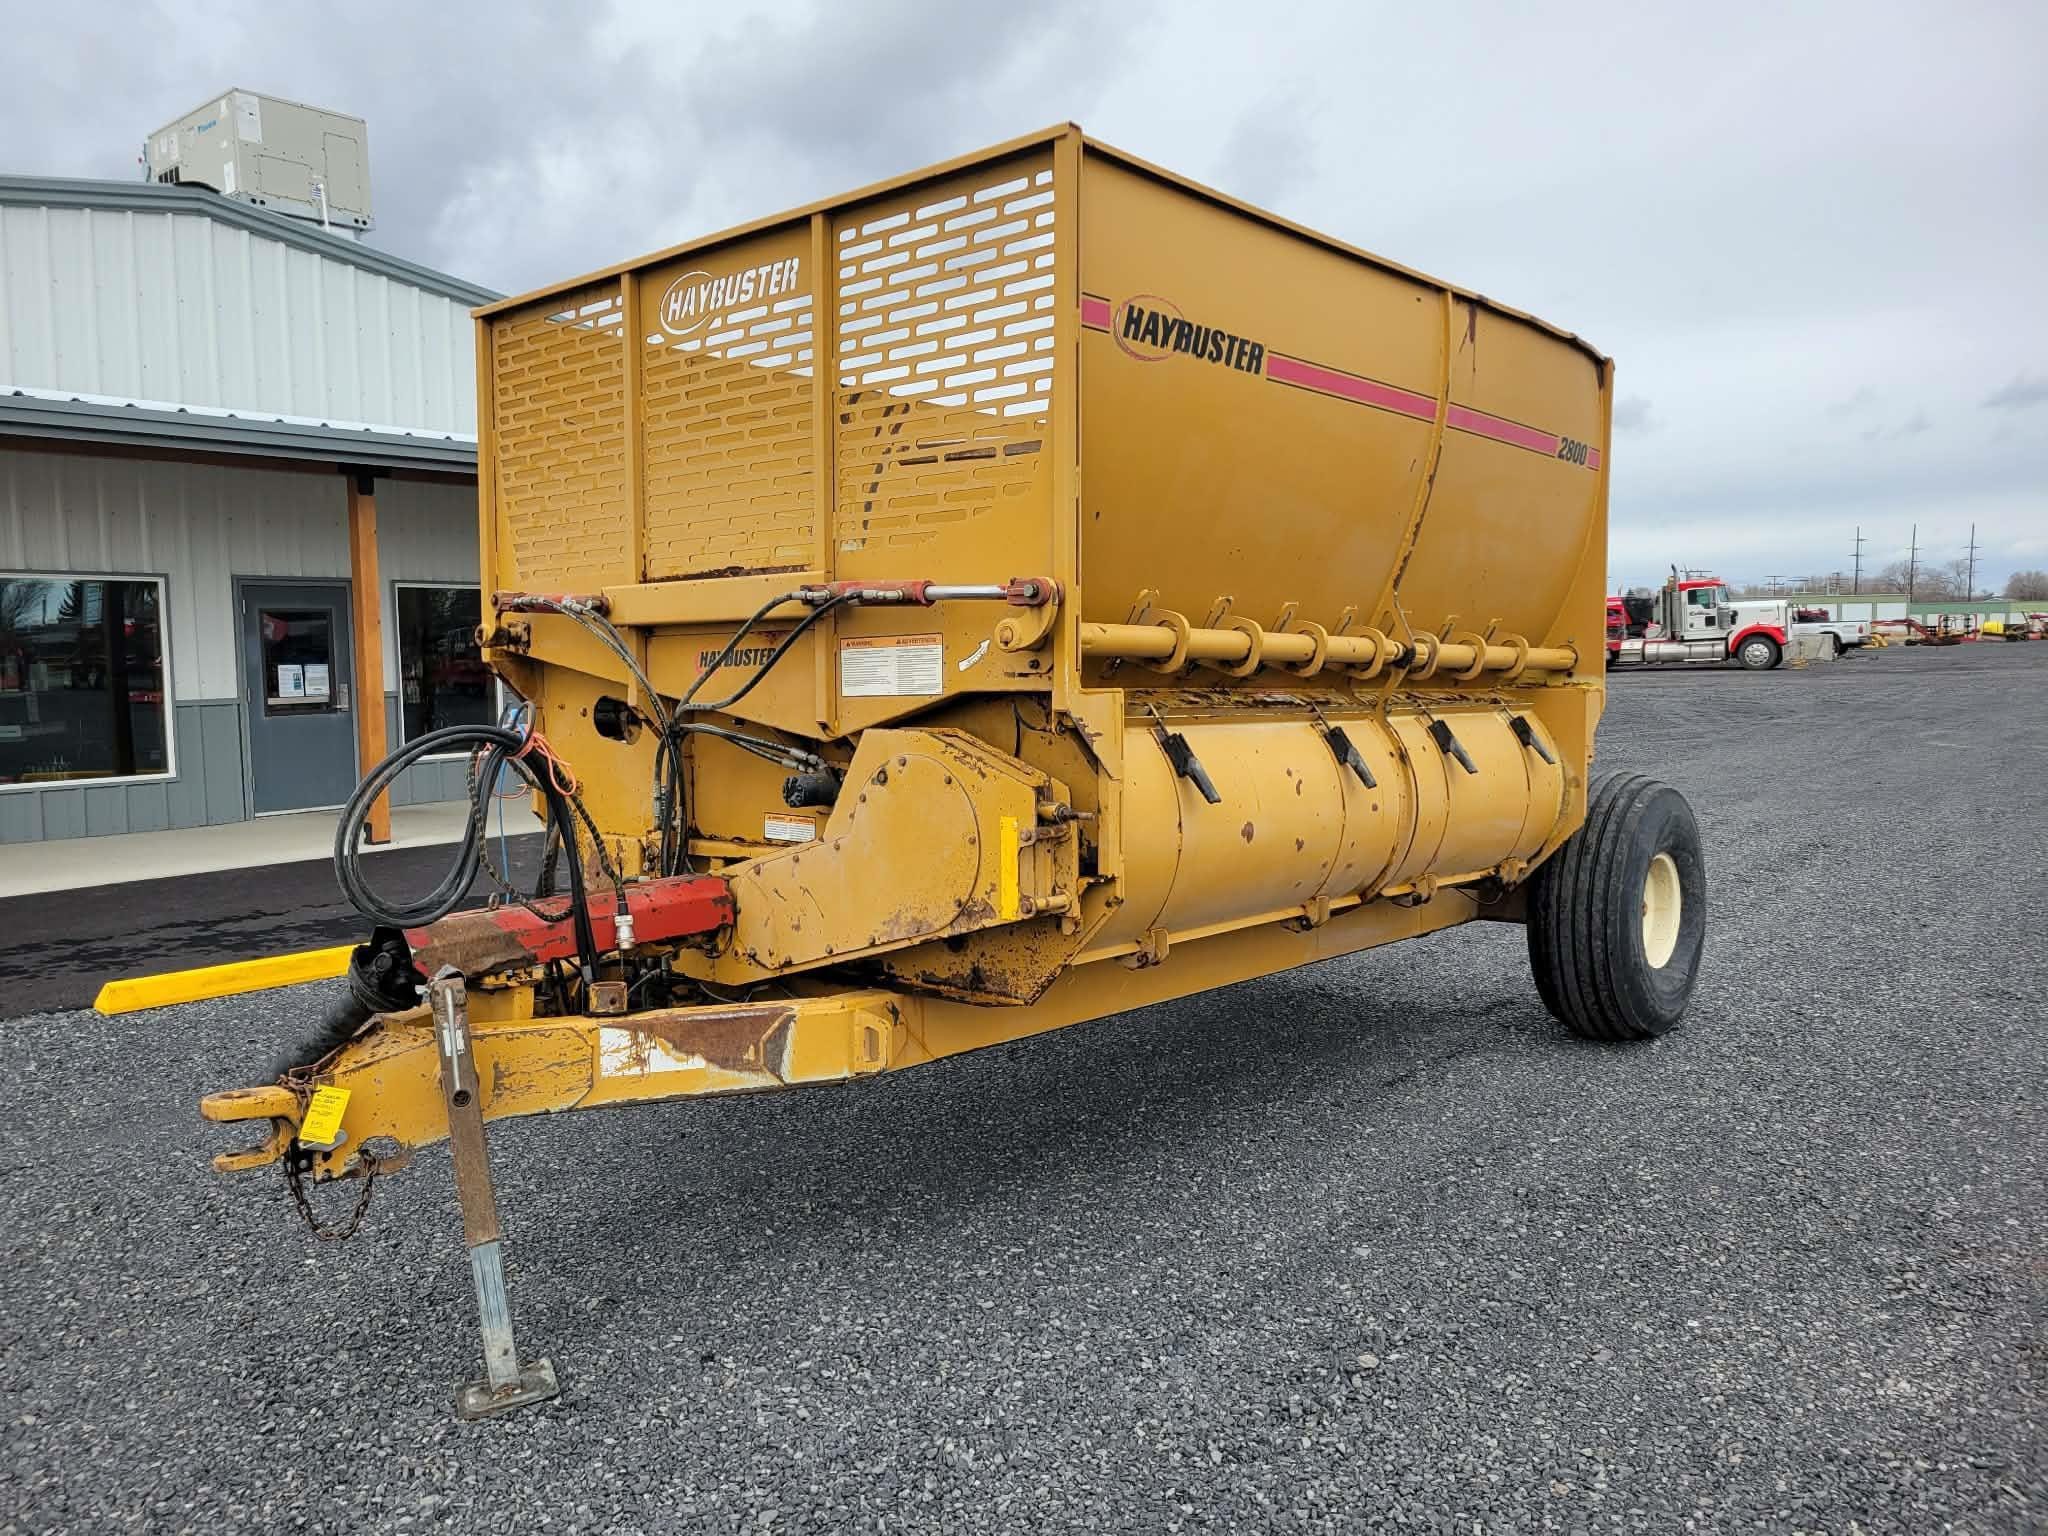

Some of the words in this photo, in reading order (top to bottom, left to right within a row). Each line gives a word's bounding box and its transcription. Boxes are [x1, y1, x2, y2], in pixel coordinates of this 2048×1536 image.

[667, 256, 800, 322] HAYBUSTER
[1123, 303, 1265, 375] HAYBUSTER
[1557, 436, 1587, 465] 2800
